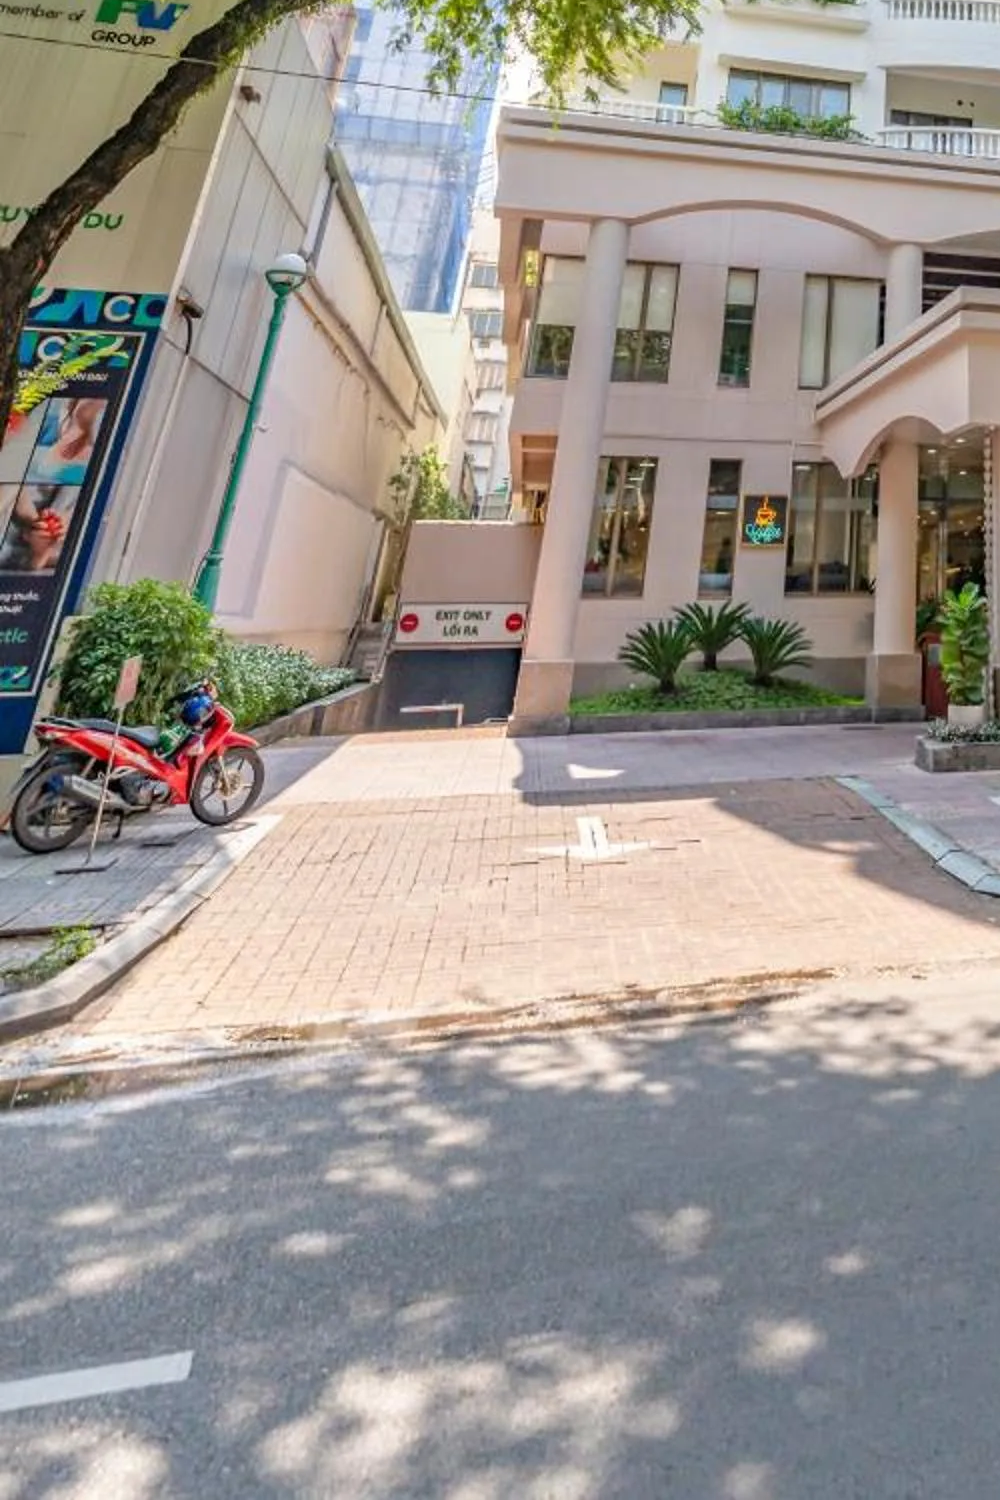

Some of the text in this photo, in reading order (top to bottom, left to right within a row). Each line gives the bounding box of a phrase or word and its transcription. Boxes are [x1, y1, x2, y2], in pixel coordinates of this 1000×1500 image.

[91, 29, 156, 46] GROUP
[83, 212, 124, 231] DU
[435, 610, 492, 621] EXIT ONLY
[463, 625, 479, 637] RA
